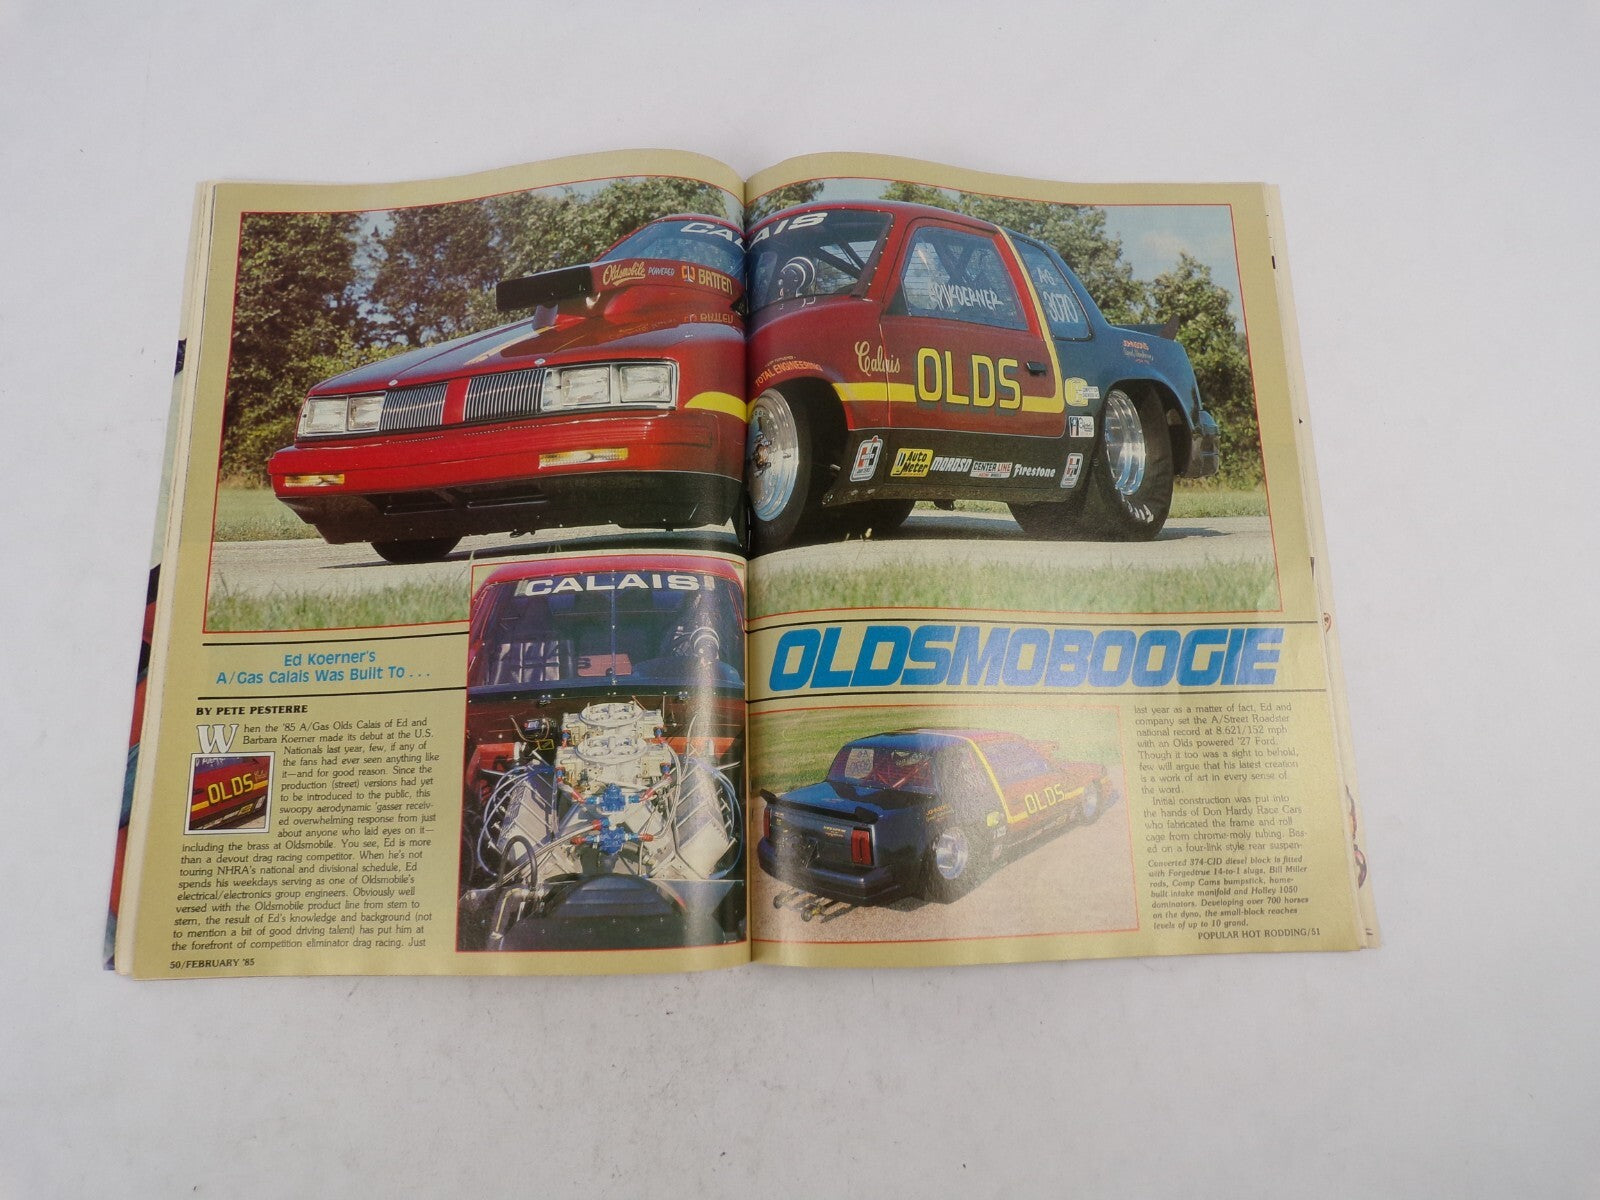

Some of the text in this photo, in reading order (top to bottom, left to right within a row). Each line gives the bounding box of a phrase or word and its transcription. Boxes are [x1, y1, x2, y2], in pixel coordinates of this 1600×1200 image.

[602, 261, 646, 287] Oldsmobile
[698, 268, 733, 295] BATTEN
[855, 341, 900, 376] Calais
[916, 348, 1021, 409] OLDS
[907, 451, 927, 462] Auto
[903, 462, 928, 473] Meter
[973, 462, 1012, 472] CENTER LINE
[1013, 463, 1056, 478] Firestone
[525, 573, 700, 597] CALAIS
[284, 651, 376, 666] Ed Koerner's
[768, 624, 1284, 692] OLDSMOBOOGIE
[216, 671, 263, 684] A/Gas
[269, 670, 309, 684] Calais
[315, 669, 344, 682] Was
[350, 667, 383, 680] Built
[196, 705, 308, 715] BY PETE PESTERRE
[262, 723, 279, 731] the
[280, 722, 297, 731] '85
[298, 721, 329, 730] A/Gas
[331, 720, 353, 729] Olds
[354, 719, 382, 728] Calais
[395, 718, 409, 727] Ed
[411, 718, 427, 726] and
[1135, 713, 1290, 726] company set the A/Street Roadster
[243, 734, 277, 744] Barbara
[317, 732, 343, 741] made
[358, 731, 384, 740] debut
[397, 730, 413, 739] the
[414, 729, 434, 738] U.S.
[1137, 727, 1171, 736] national
[1173, 726, 1201, 735] record
[1215, 725, 1266, 734] 8.621/152
[1267, 724, 1287, 735] mph
[284, 744, 323, 754] Nationals
[324, 744, 342, 753] last
[343, 745, 365, 754] year,
[366, 742, 387, 753] few,
[397, 744, 416, 752] any
[282, 757, 298, 765] the
[299, 756, 319, 765] fans
[321, 756, 339, 764] had
[385, 753, 423, 764] anything
[424, 753, 439, 761] like
[315, 768, 329, 776] for
[331, 767, 354, 778] good
[389, 765, 417, 774] Since
[418, 765, 432, 773] the
[208, 773, 254, 804] OLDS
[281, 776, 433, 791] production (street) versions had yet
[292, 792, 305, 801] be
[306, 791, 352, 800] introduced
[366, 790, 381, 798] the
[382, 789, 414, 800] public,
[415, 788, 431, 797] this
[1025, 783, 1065, 814] OLDS
[280, 801, 434, 814] swoopy aerodynamic 'gasser receiv-
[291, 815, 355, 826] overwhelming
[357, 816, 396, 825] response
[397, 814, 419, 822] from
[420, 813, 436, 824] just
[277, 828, 303, 836] about
[305, 829, 339, 838] anyone
[341, 827, 361, 835] who
[363, 826, 380, 835] laid
[381, 828, 402, 836] eyes
[182, 842, 224, 853] including
[226, 841, 243, 850] the
[244, 841, 270, 849] brass
[285, 839, 339, 849] Oldsmobile.
[340, 839, 359, 847] You
[361, 841, 382, 849] see,
[181, 854, 202, 863] than
[213, 853, 249, 862] devout
[250, 853, 272, 864] drag
[274, 852, 303, 863] racing
[304, 851, 357, 862] competitor.
[359, 851, 386, 859] When
[387, 850, 407, 859] he's
[408, 850, 423, 858] not
[180, 866, 215, 877] touring
[216, 865, 256, 874] NHRA's
[257, 864, 295, 873] national
[296, 864, 315, 873] and
[316, 863, 358, 872] divisional
[360, 862, 403, 873] schedule,
[1199, 927, 1320, 940] POPULAR HOT RODDING/51
[170, 957, 255, 969] 50/FEBRUARY '85
